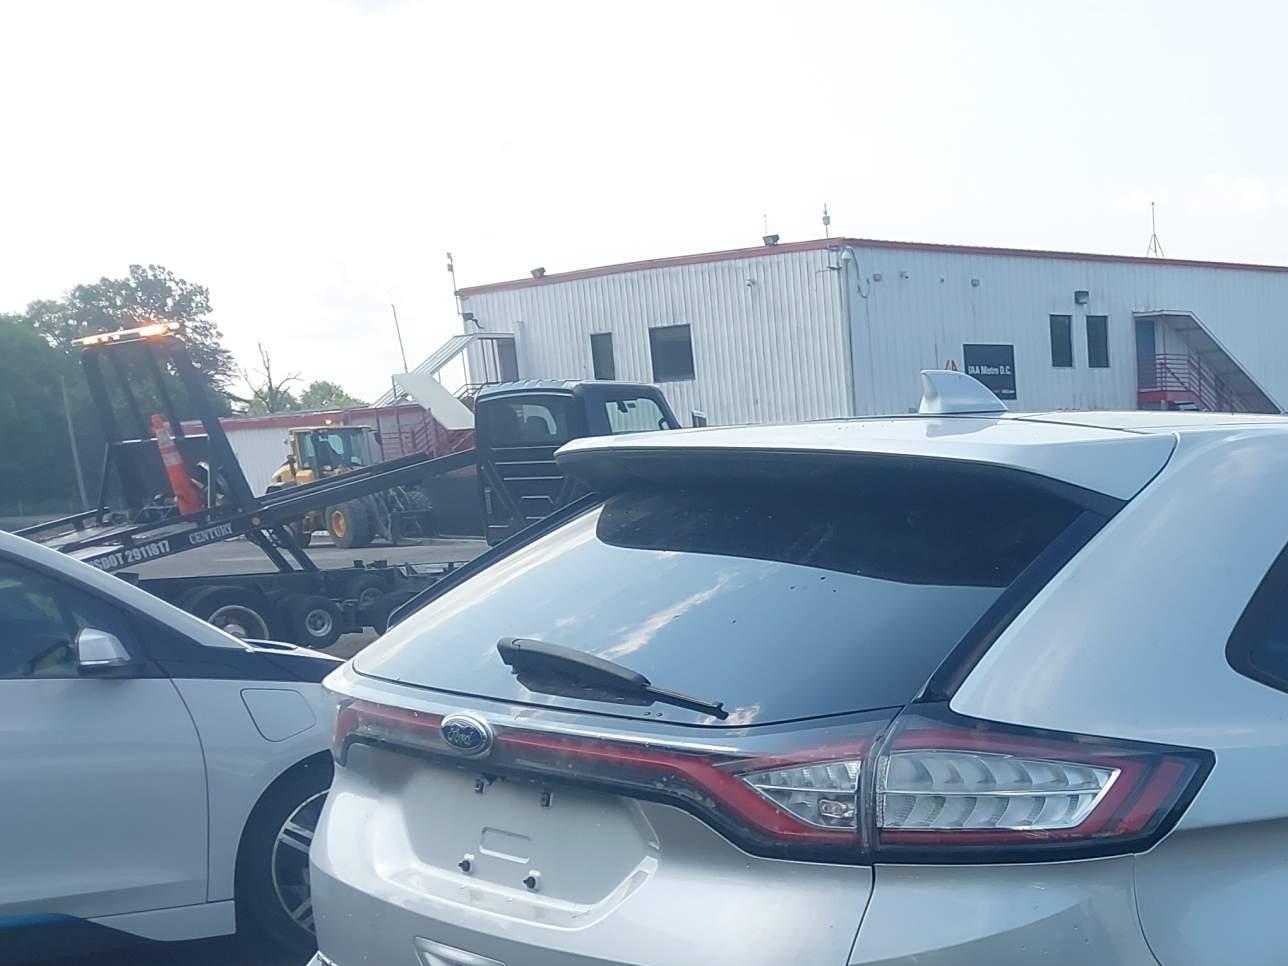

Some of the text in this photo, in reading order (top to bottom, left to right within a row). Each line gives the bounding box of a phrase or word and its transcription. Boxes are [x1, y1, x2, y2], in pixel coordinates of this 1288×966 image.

[967, 365, 980, 375] IAA
[188, 522, 233, 545] CENTURY
[126, 540, 171, 563] 2911817
